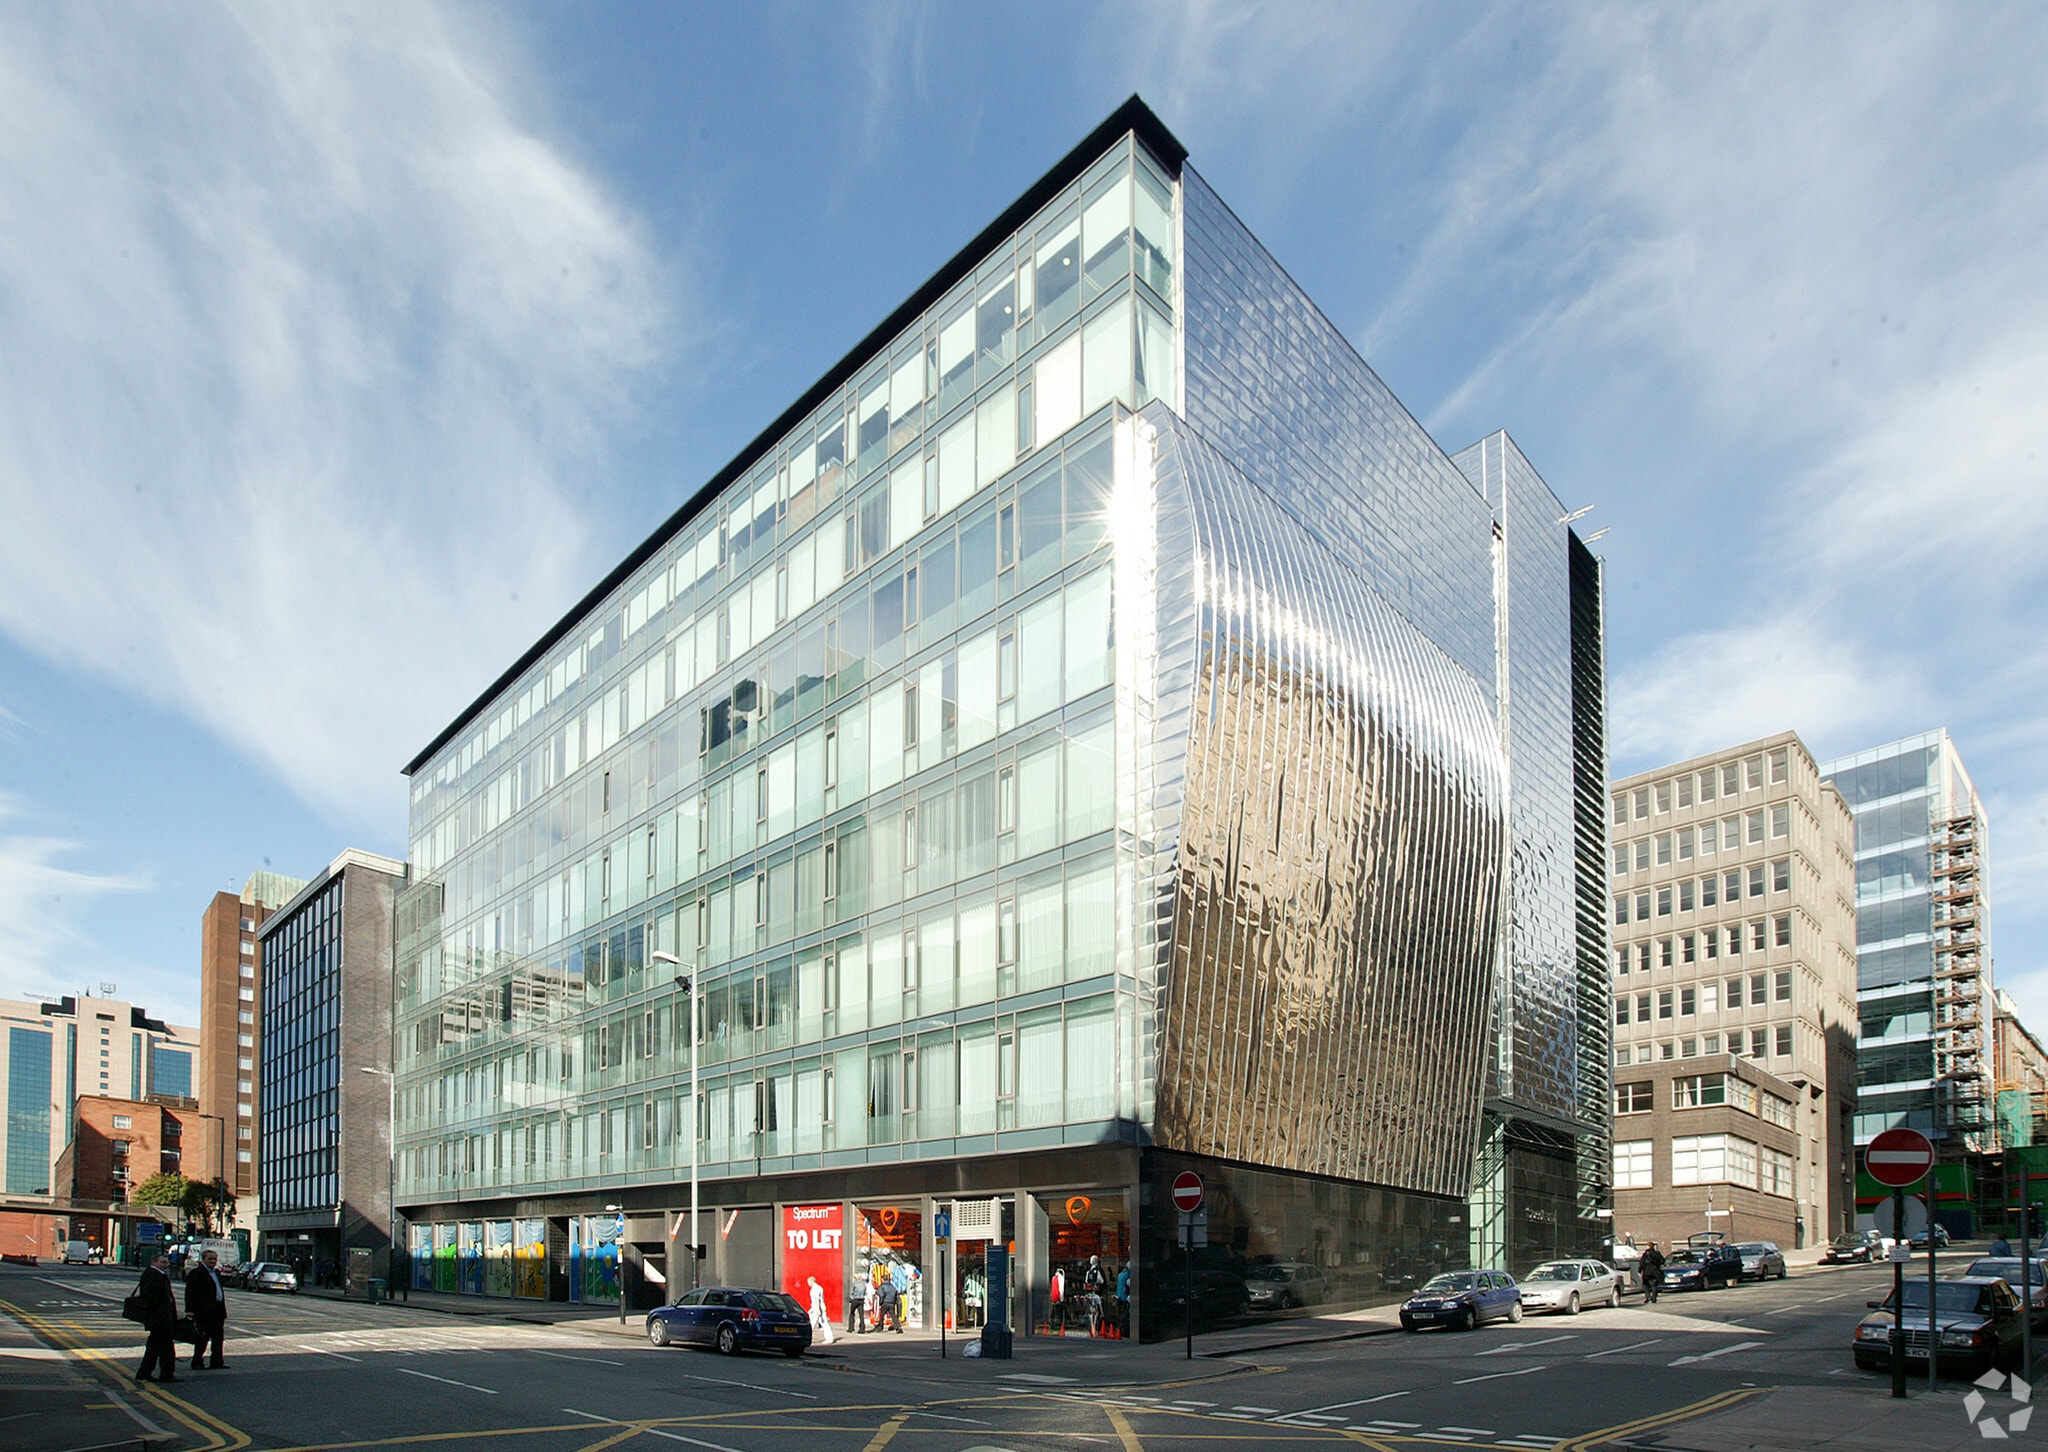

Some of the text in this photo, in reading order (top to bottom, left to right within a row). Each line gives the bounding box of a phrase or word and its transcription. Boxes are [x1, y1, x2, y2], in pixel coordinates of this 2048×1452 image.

[793, 1207, 829, 1222] Spectrum
[787, 1229, 842, 1249] TO LET
